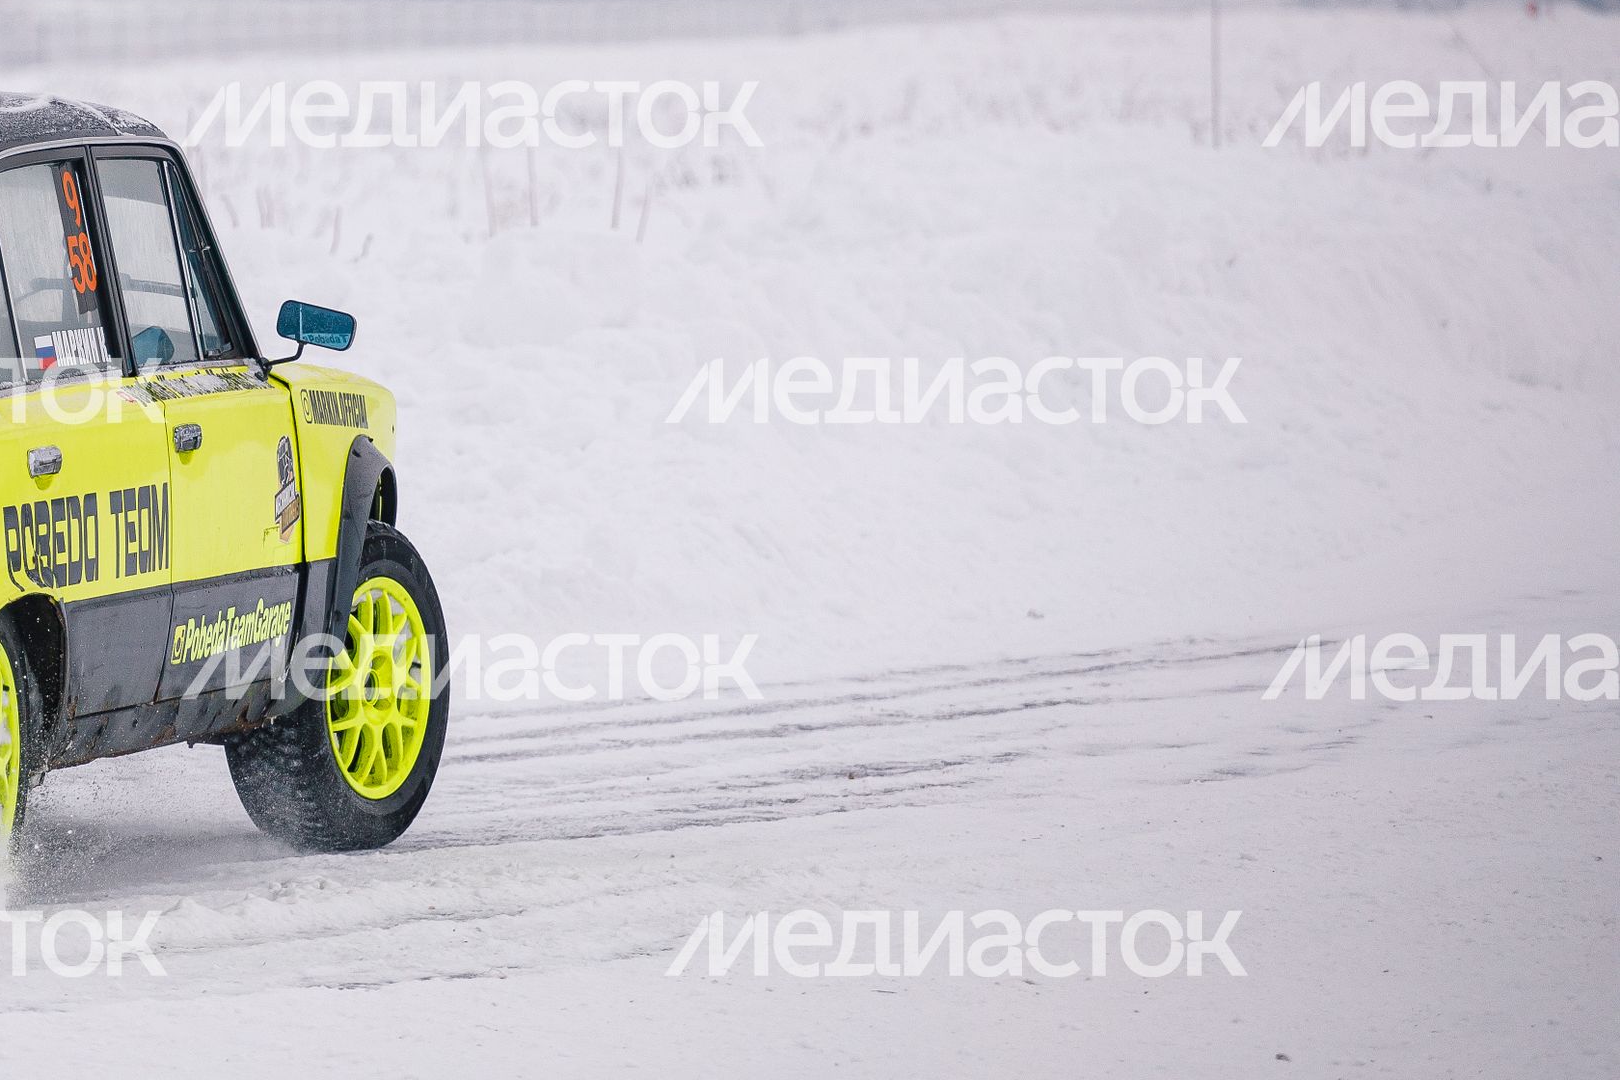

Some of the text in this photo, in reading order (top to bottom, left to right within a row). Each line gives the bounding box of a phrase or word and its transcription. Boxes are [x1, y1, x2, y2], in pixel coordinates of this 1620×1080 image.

[62, 170, 81, 228] 9
[66, 231, 97, 294] 58
[183, 597, 292, 663] PobedaTeamGarage
